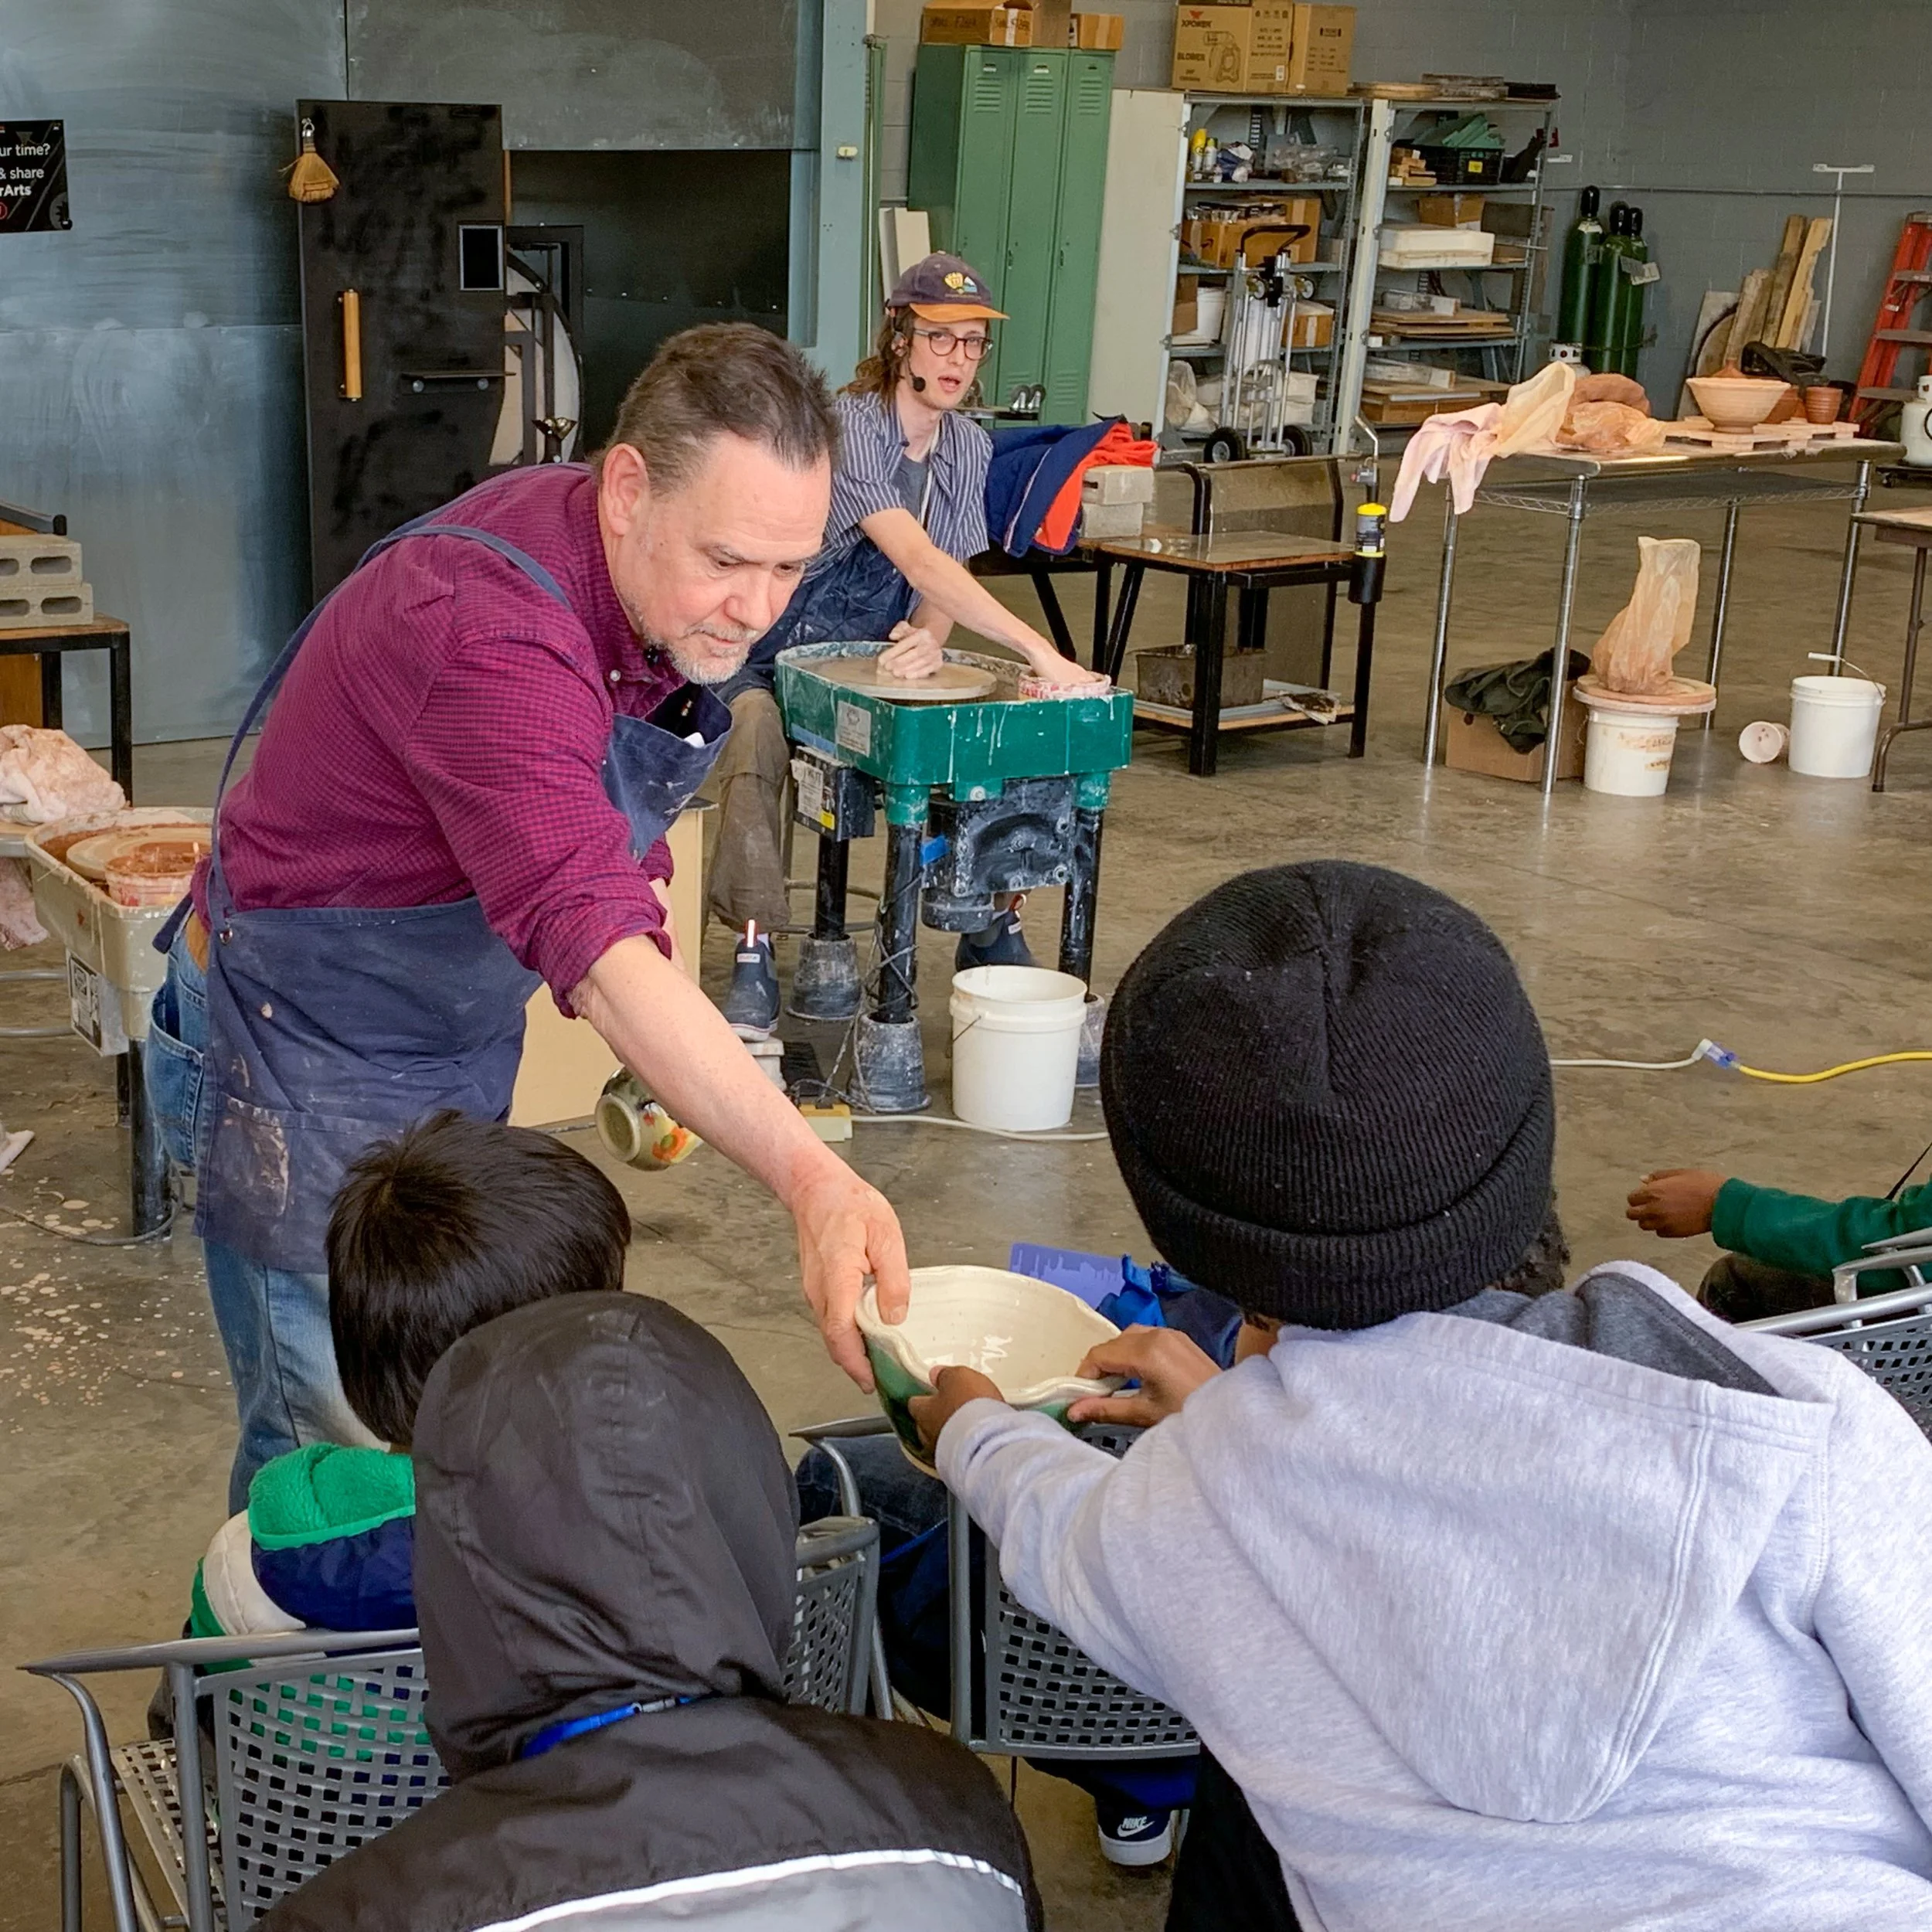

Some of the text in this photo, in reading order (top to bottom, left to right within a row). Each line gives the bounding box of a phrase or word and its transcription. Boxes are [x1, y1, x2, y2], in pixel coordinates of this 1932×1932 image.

[15, 143, 50, 156] time?
[10, 167, 44, 179] share
[1122, 1816, 1147, 1829] NIKE
